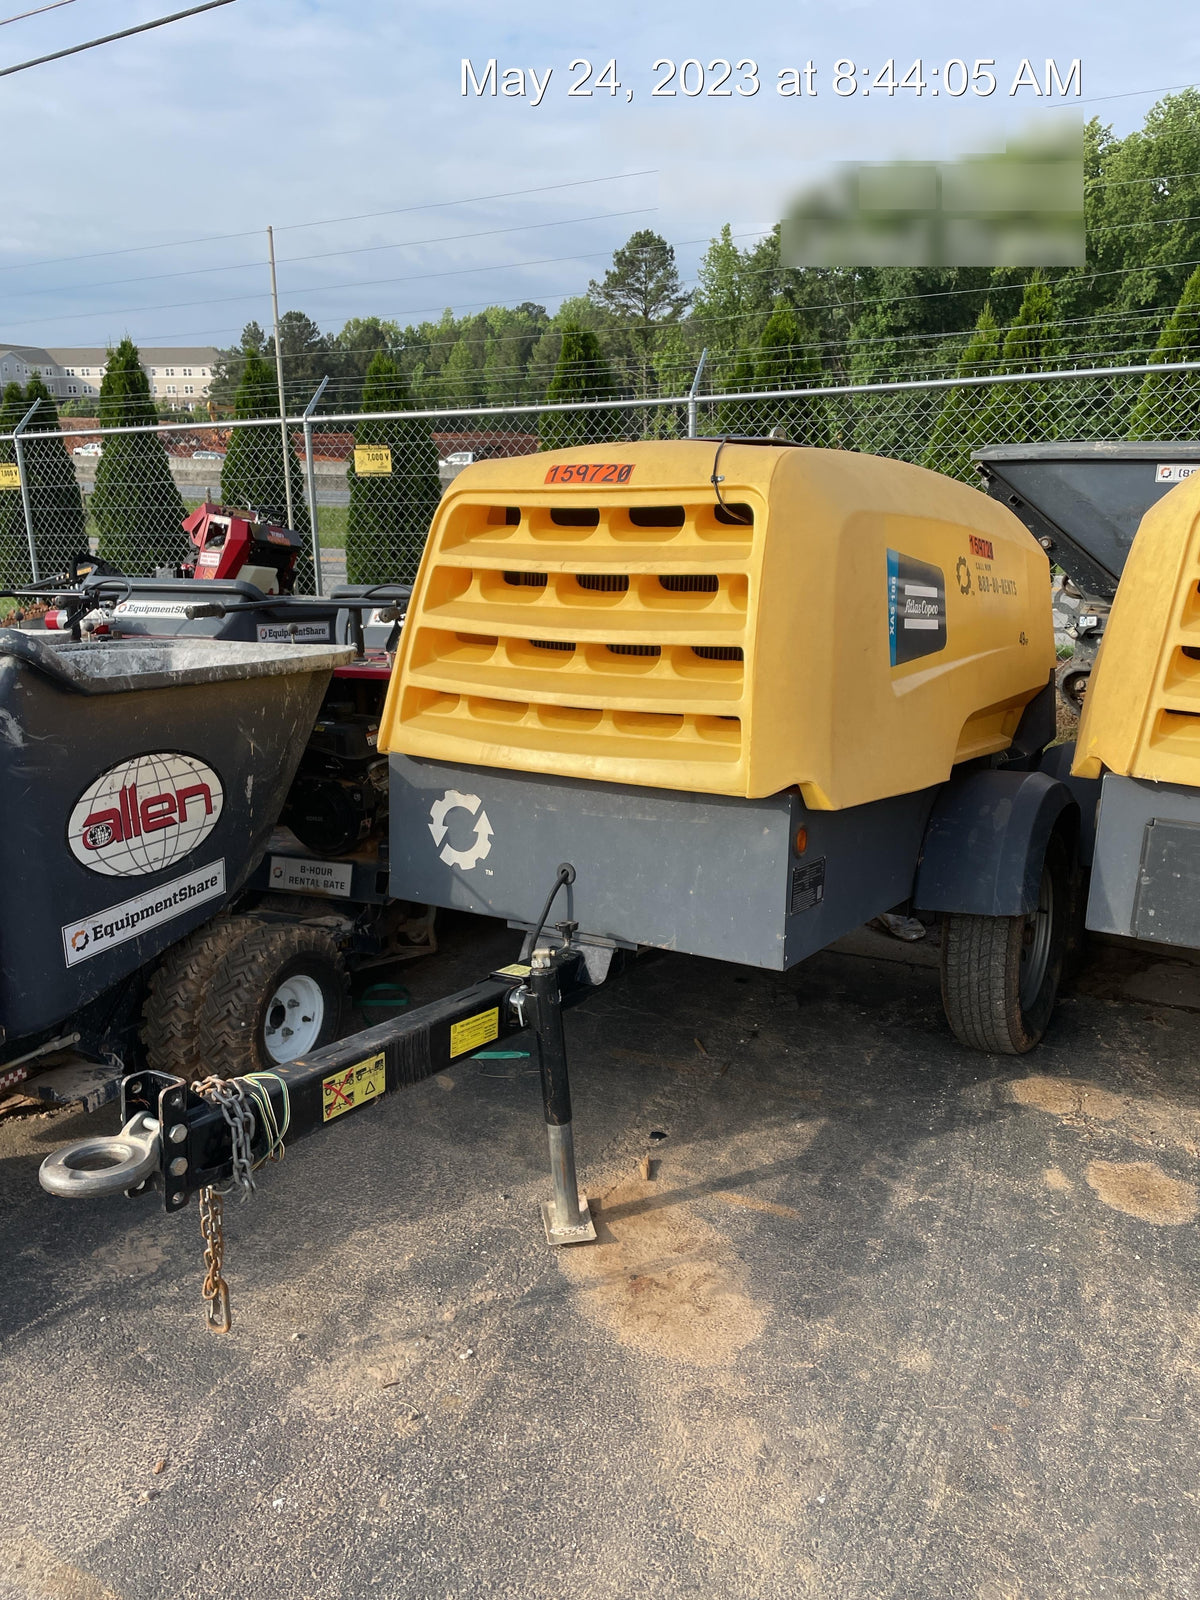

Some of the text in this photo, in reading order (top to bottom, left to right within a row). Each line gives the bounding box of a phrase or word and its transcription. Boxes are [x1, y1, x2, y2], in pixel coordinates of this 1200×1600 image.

[550, 464, 633, 483] 159720
[969, 536, 994, 560] 159720
[904, 599, 939, 617] Atlas Copco
[82, 782, 213, 851] allen
[288, 876, 346, 890] RENTAL RATE
[91, 875, 219, 942] EquipmentShare
